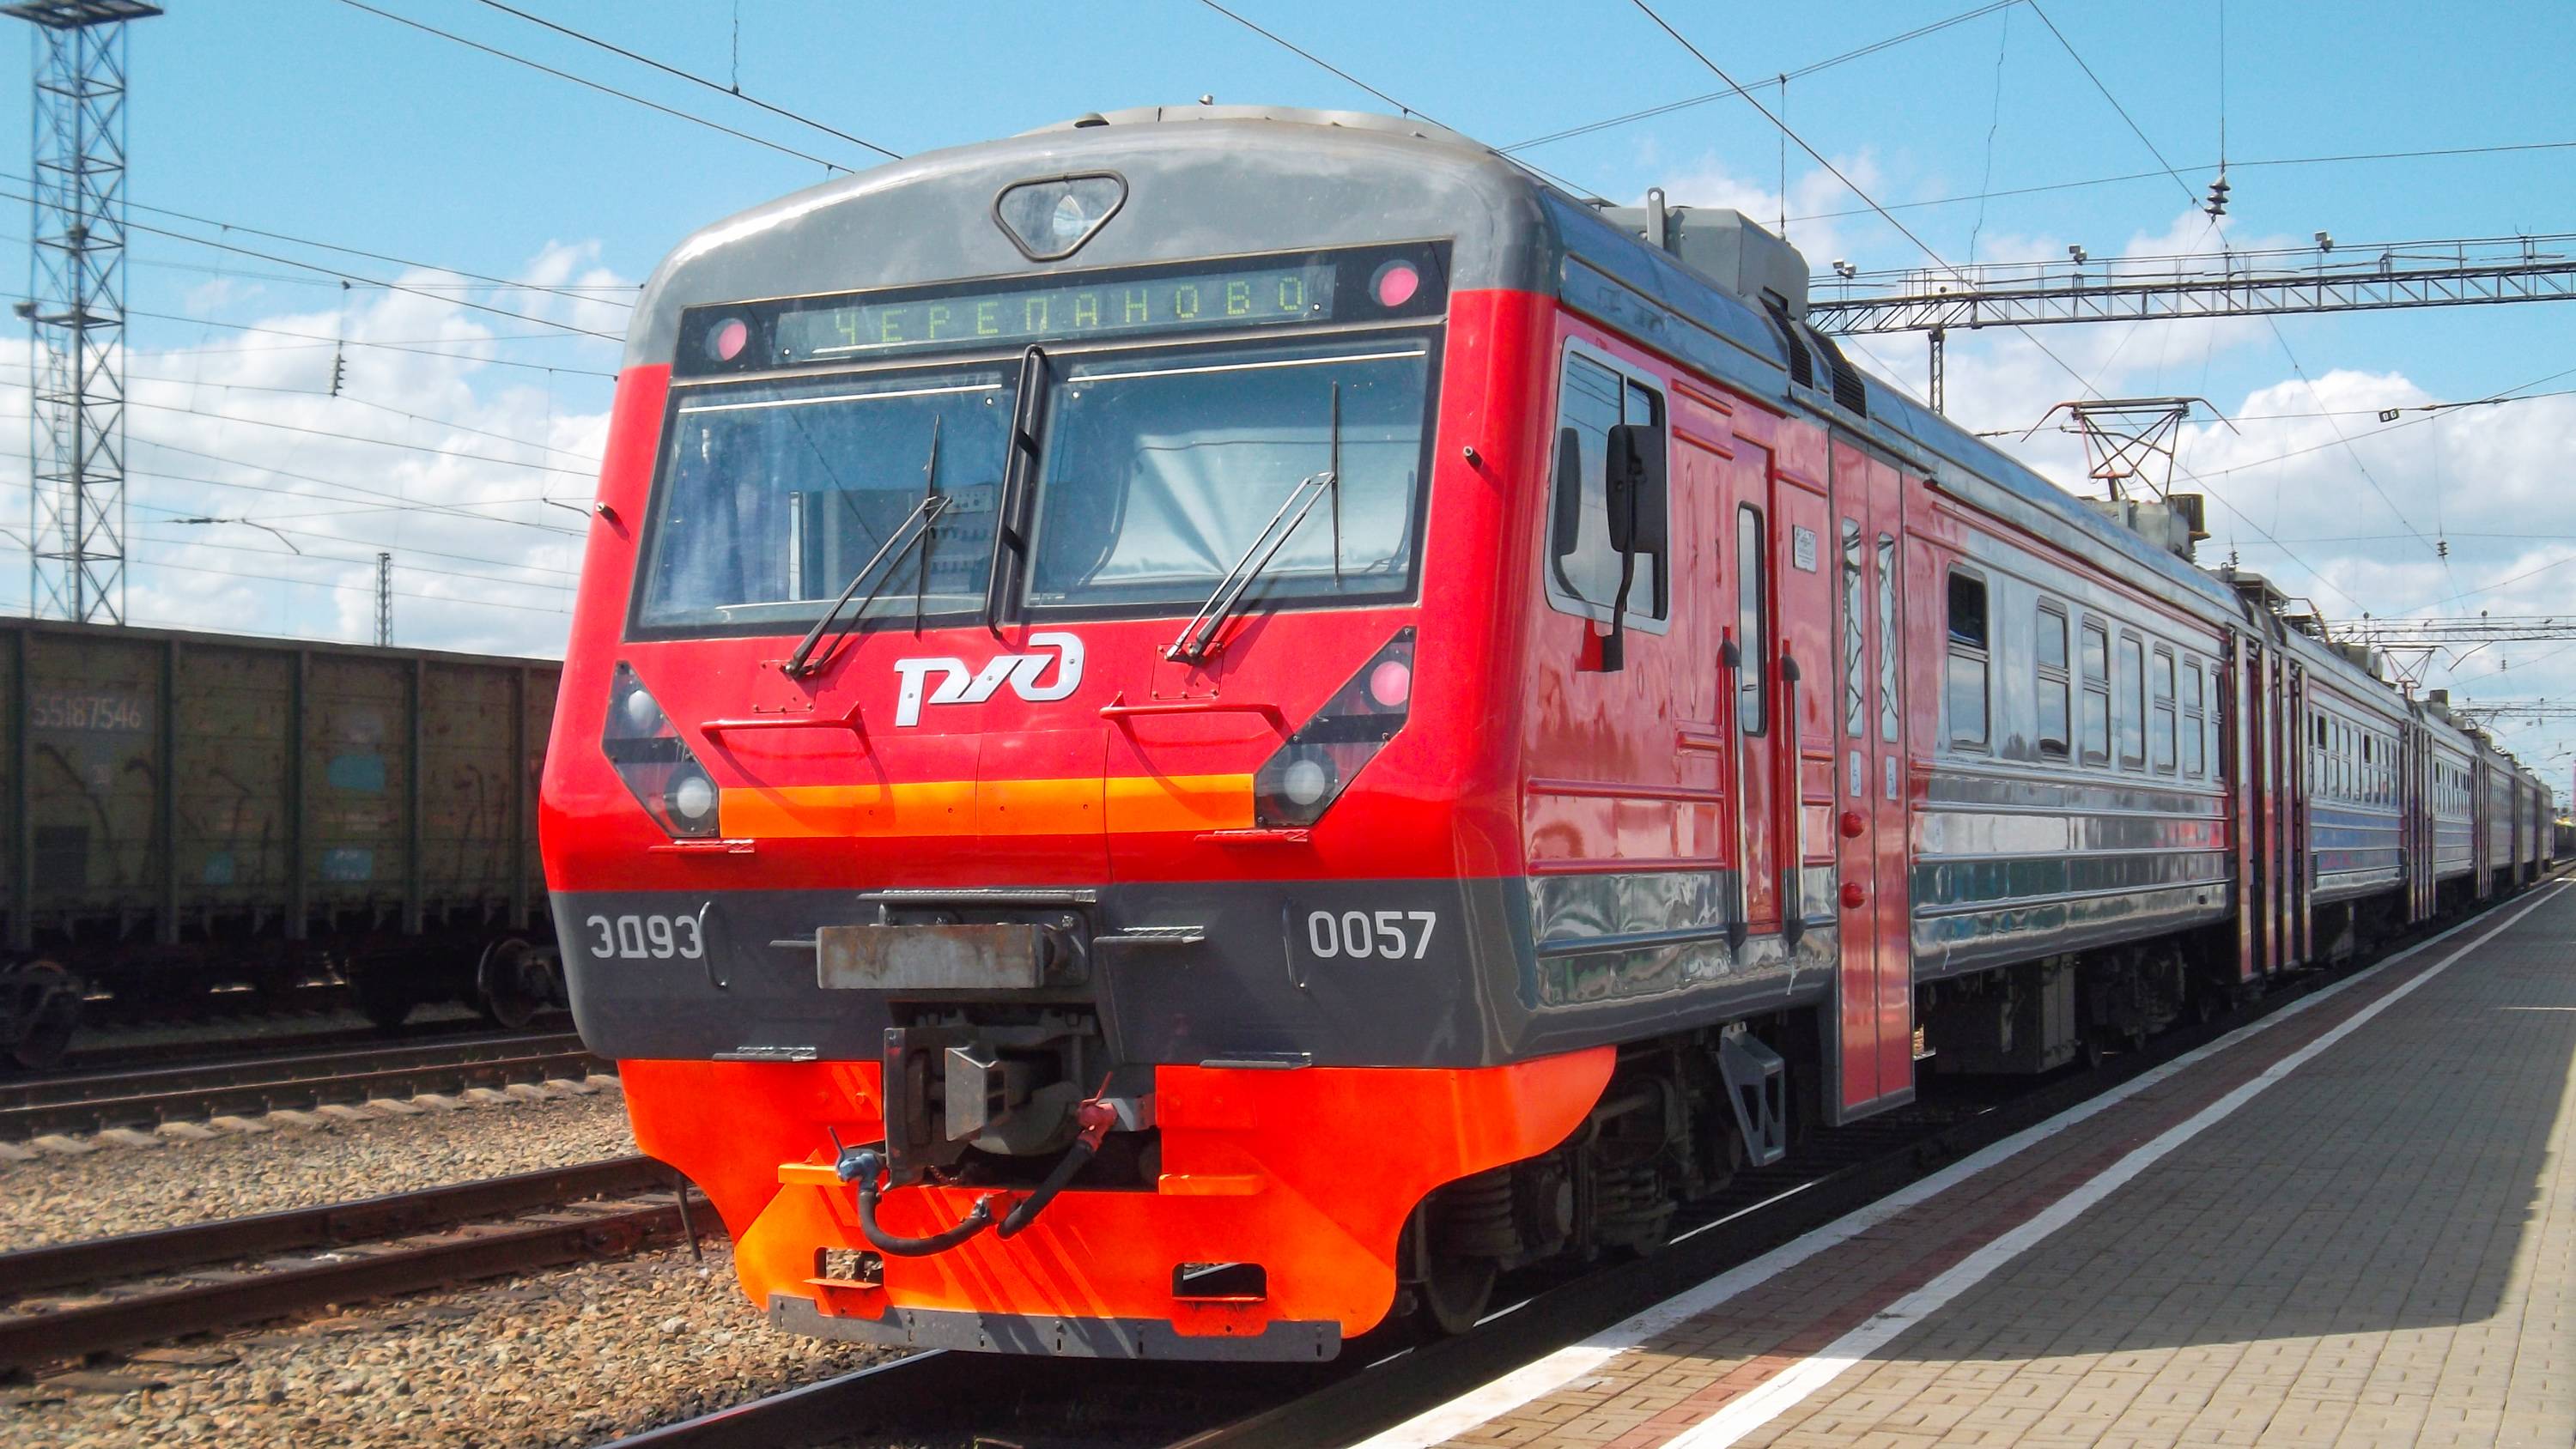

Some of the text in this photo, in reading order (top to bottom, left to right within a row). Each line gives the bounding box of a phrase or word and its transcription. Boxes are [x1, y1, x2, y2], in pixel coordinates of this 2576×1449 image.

[835, 277, 1303, 344] ЧЕРЕПАНОВО
[894, 632, 1084, 727] РЖД
[1308, 910, 1437, 960] 0057
